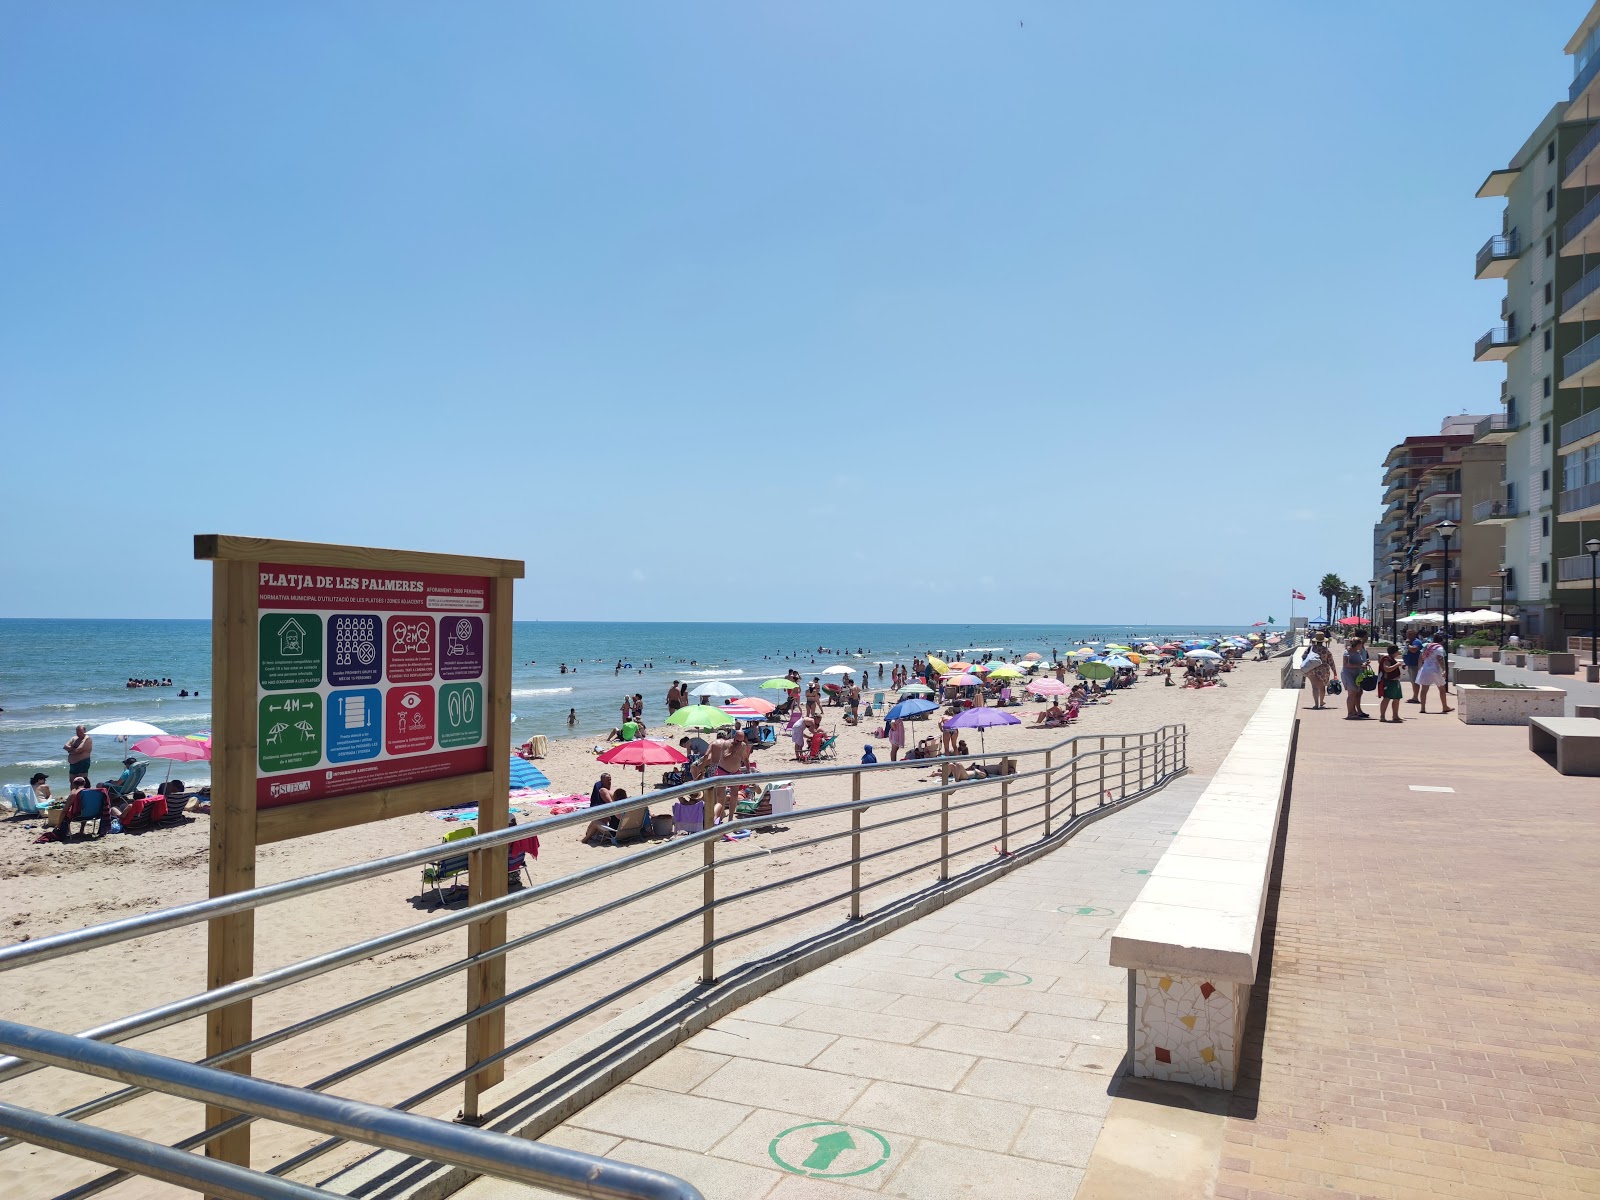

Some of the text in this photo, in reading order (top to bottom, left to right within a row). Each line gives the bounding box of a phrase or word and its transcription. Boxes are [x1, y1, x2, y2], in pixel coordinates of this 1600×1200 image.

[260, 573, 425, 592] PLATJA DE LES PALMERES
[283, 698, 300, 712] 4M
[280, 781, 310, 794] SUECA
